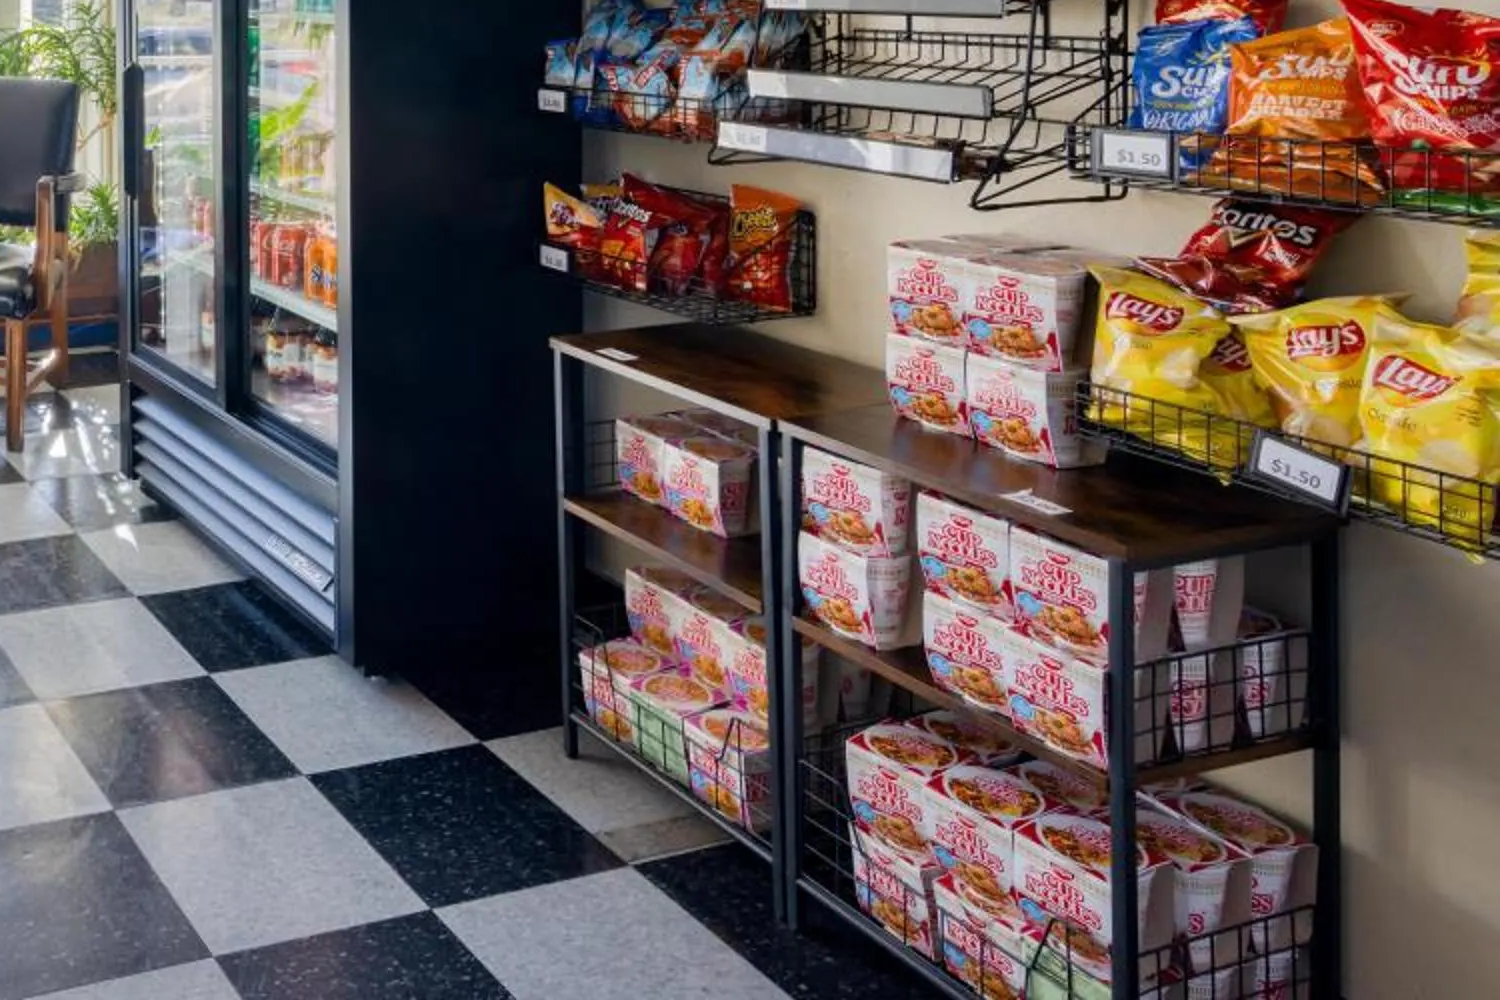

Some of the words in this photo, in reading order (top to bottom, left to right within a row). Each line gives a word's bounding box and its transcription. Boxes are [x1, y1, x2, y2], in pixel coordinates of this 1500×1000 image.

[1116, 148, 1161, 167] $1.50
[1108, 293, 1181, 326] Lay's
[1270, 456, 1322, 490] $1.50
